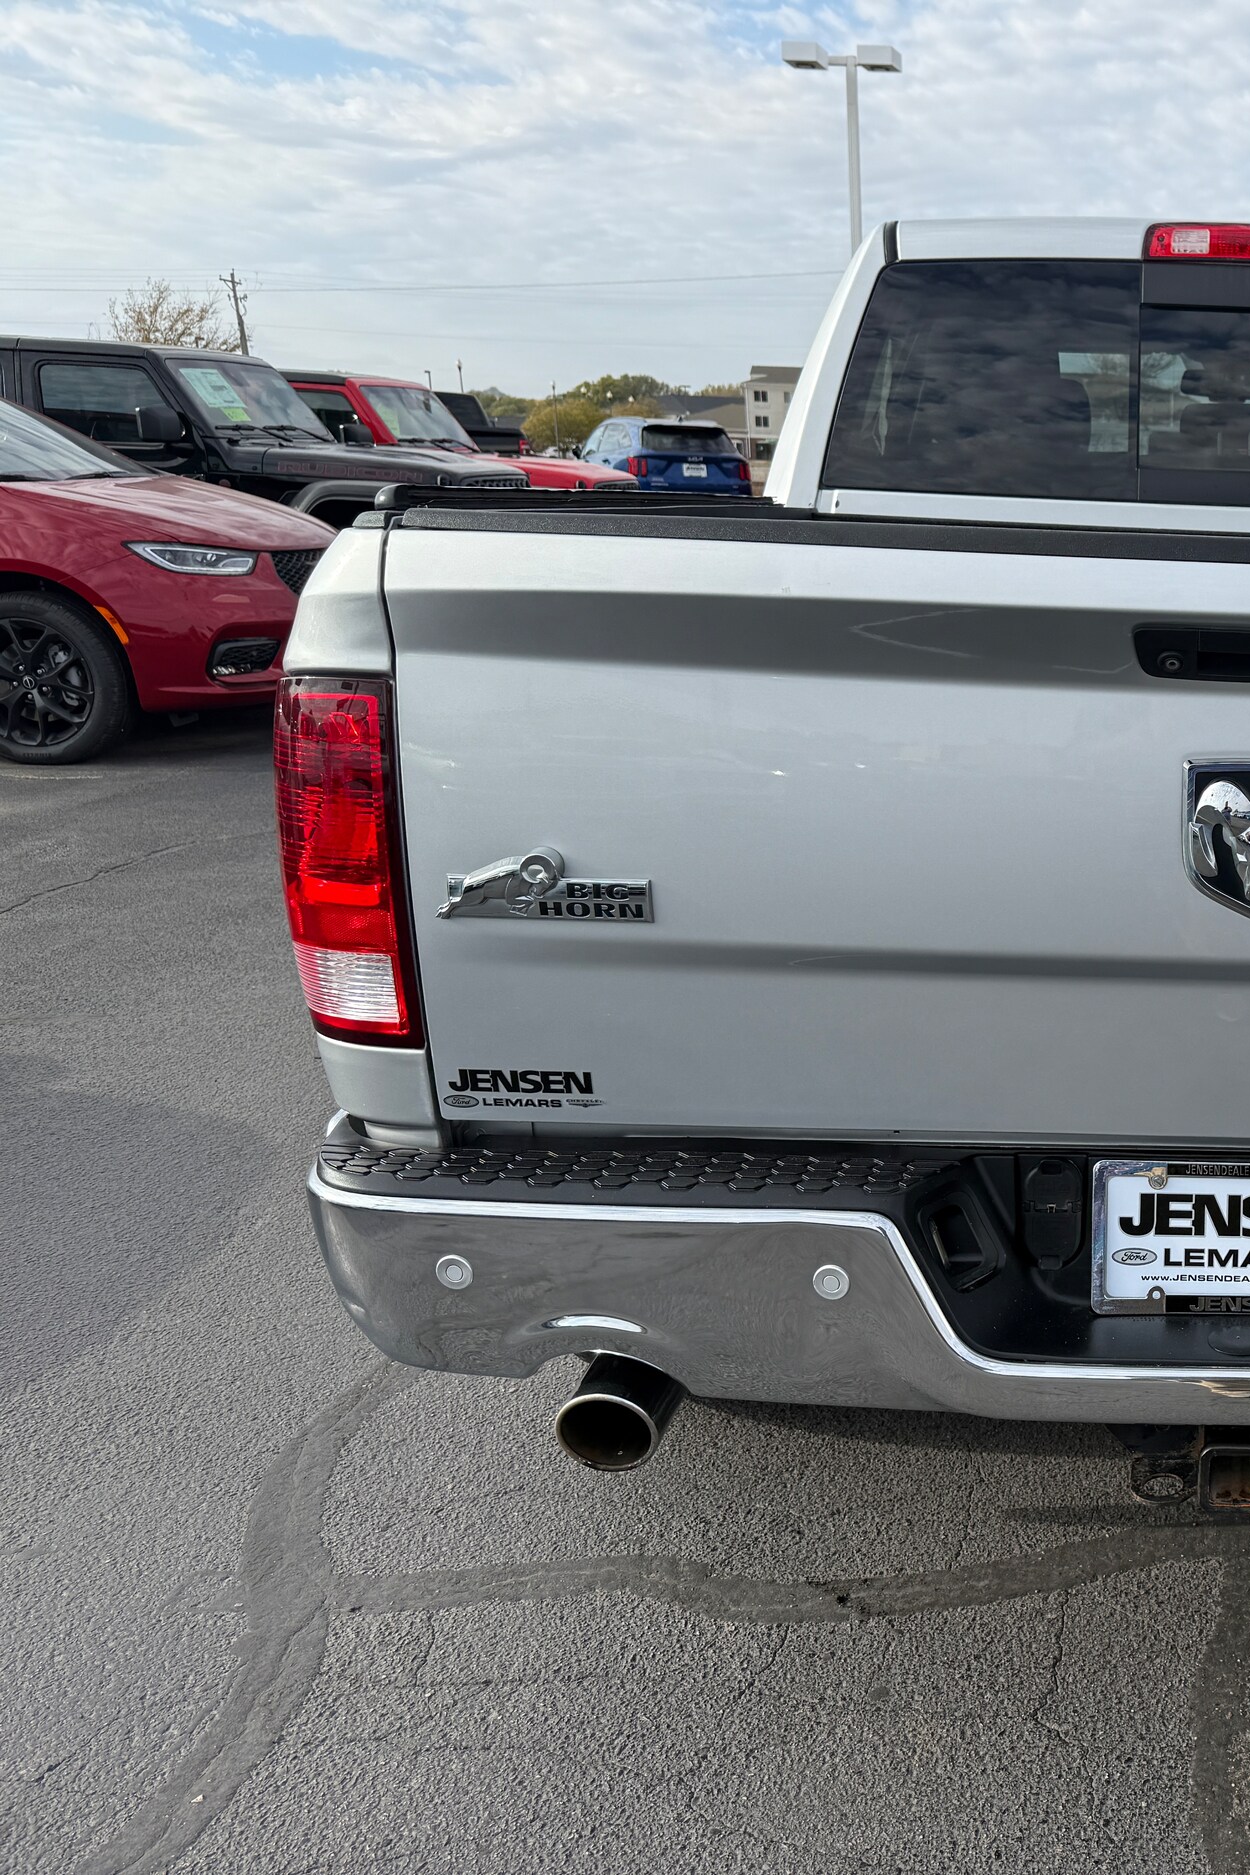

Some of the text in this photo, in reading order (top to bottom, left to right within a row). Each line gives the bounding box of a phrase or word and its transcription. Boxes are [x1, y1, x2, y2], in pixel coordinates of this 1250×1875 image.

[277, 461, 424, 483] RUBICON
[566, 883, 630, 901] BIG
[539, 901, 645, 919] HORN
[448, 1068, 594, 1095] JENSEN
[482, 1097, 562, 1108] LEMARS
